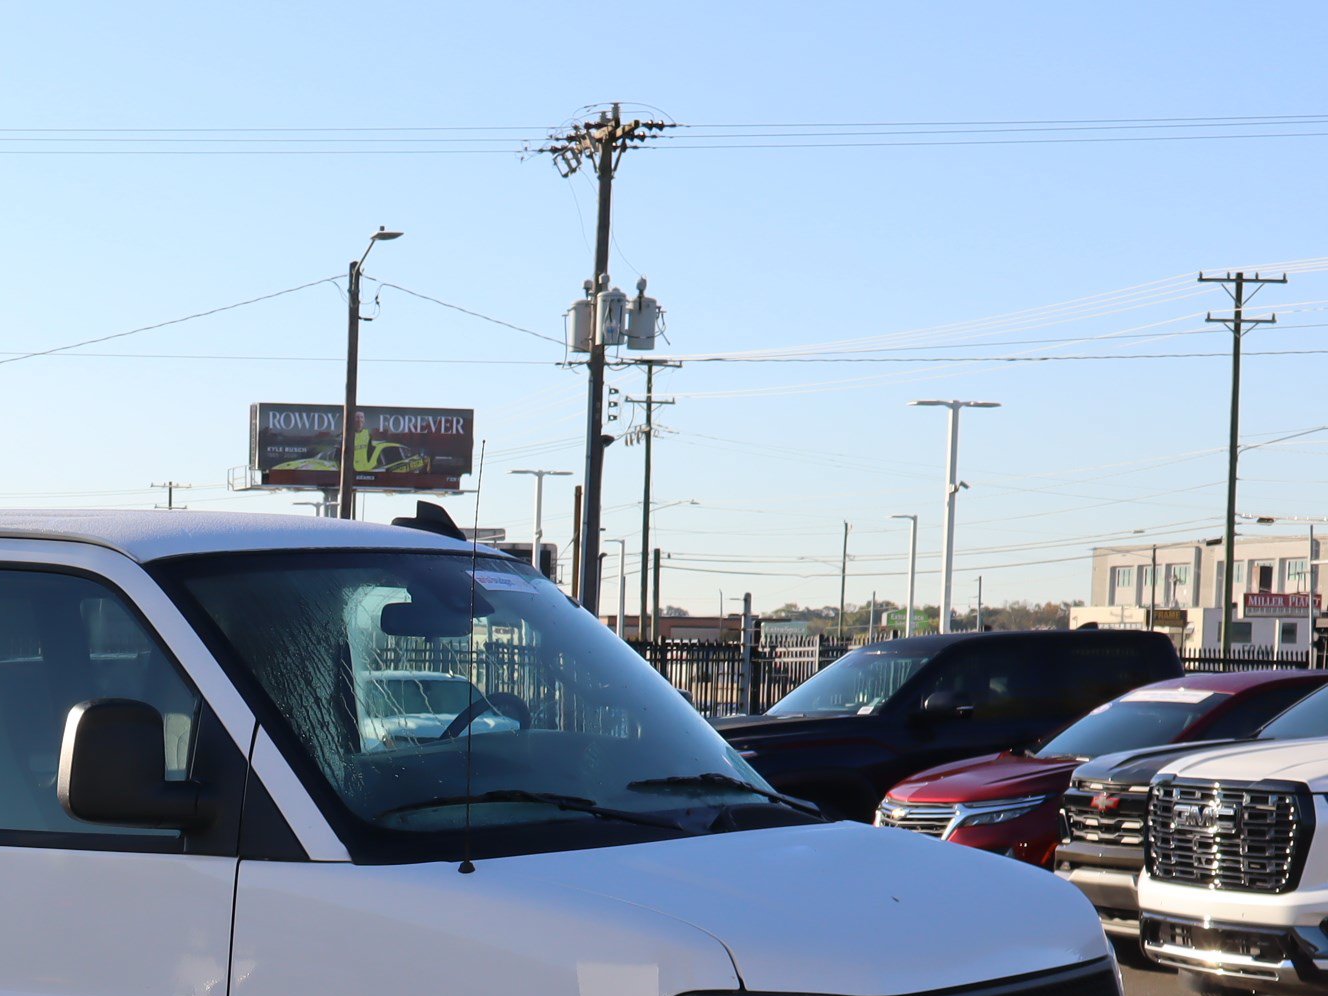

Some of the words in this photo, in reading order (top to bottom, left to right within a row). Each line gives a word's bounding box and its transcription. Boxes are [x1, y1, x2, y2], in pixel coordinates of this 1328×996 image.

[268, 411, 340, 431] ROWDY
[379, 414, 465, 435] FOREVER
[1248, 595, 1284, 606] MILLER
[1173, 804, 1235, 829] GMC
